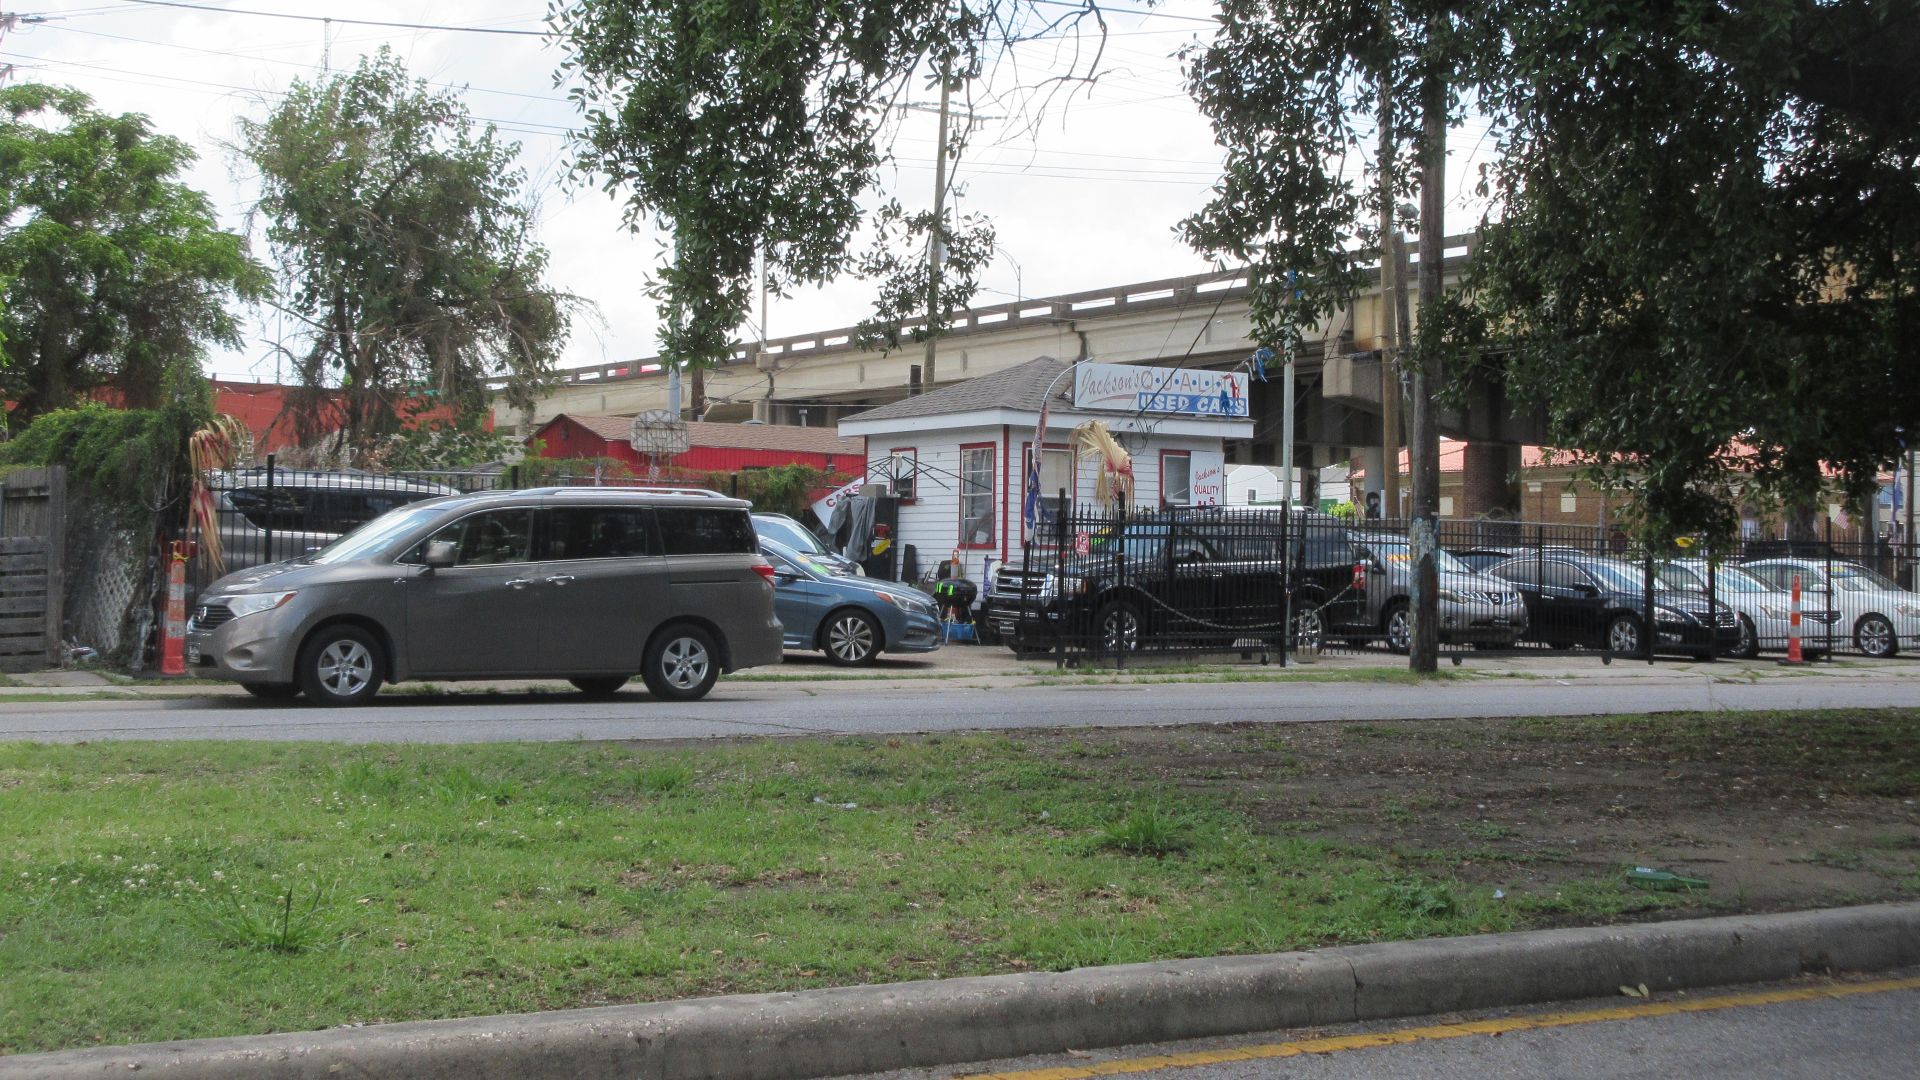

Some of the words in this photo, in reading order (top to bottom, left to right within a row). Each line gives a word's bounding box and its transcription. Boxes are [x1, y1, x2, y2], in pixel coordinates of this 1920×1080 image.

[1140, 394, 1190, 412] USED
[1197, 396, 1246, 415] CARS
[1193, 484, 1219, 496] QUALITY
